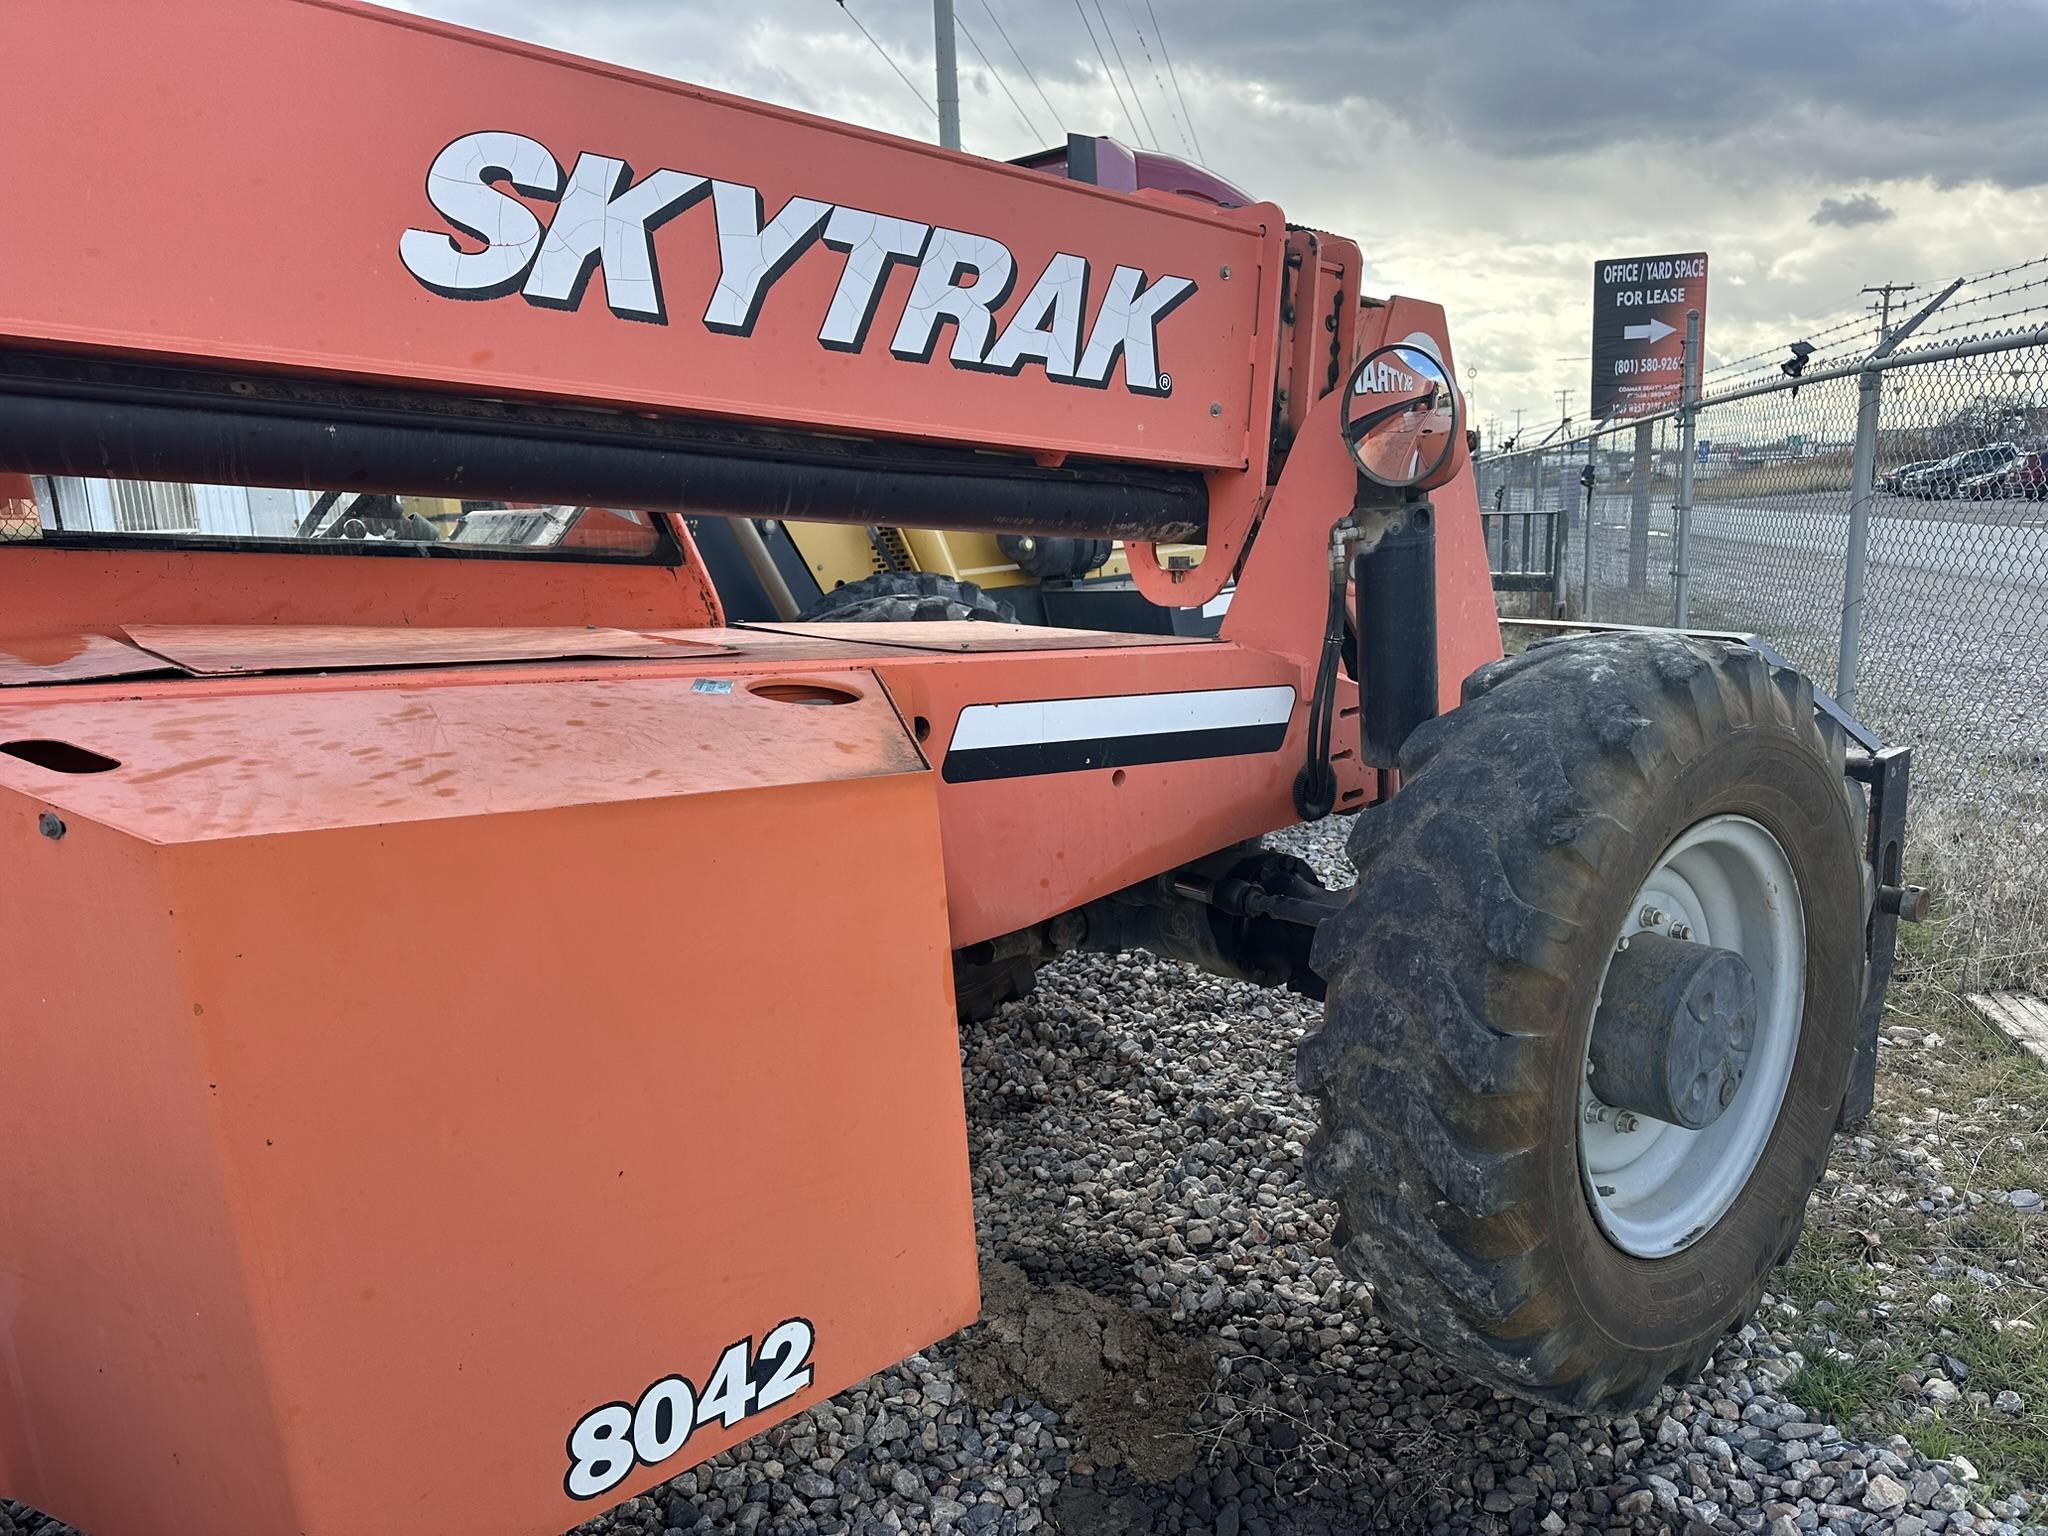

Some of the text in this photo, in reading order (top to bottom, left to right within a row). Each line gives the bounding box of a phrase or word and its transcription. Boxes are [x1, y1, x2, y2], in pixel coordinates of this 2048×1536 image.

[1604, 263, 1638, 284] OFFICE
[1646, 260, 1672, 281] YARD
[1675, 258, 1705, 278] SPACE
[1616, 287, 1686, 307] FOR LEASE
[1614, 359, 1638, 376] (801)
[564, 1317, 815, 1500] 8042
